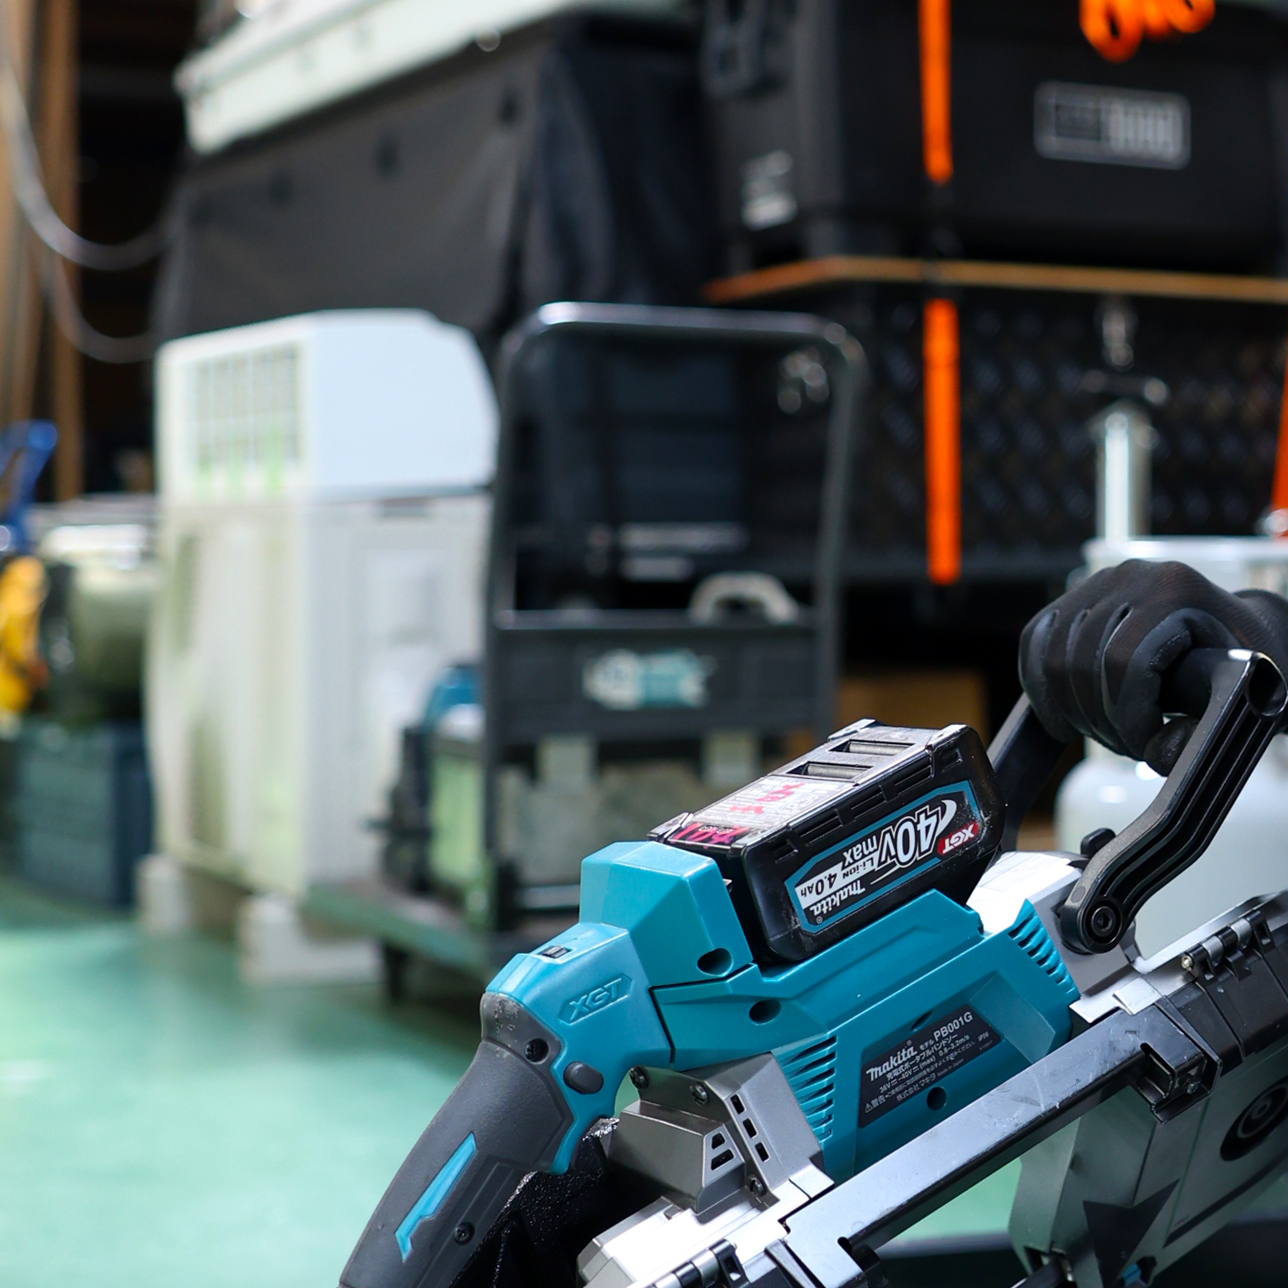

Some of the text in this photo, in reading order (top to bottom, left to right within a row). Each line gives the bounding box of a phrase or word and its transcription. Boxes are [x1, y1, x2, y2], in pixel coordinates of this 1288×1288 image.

[842, 834, 878, 865] max
[942, 824, 975, 854] XGT
[569, 978, 622, 1020] XGT
[933, 1012, 974, 1041] PB001G
